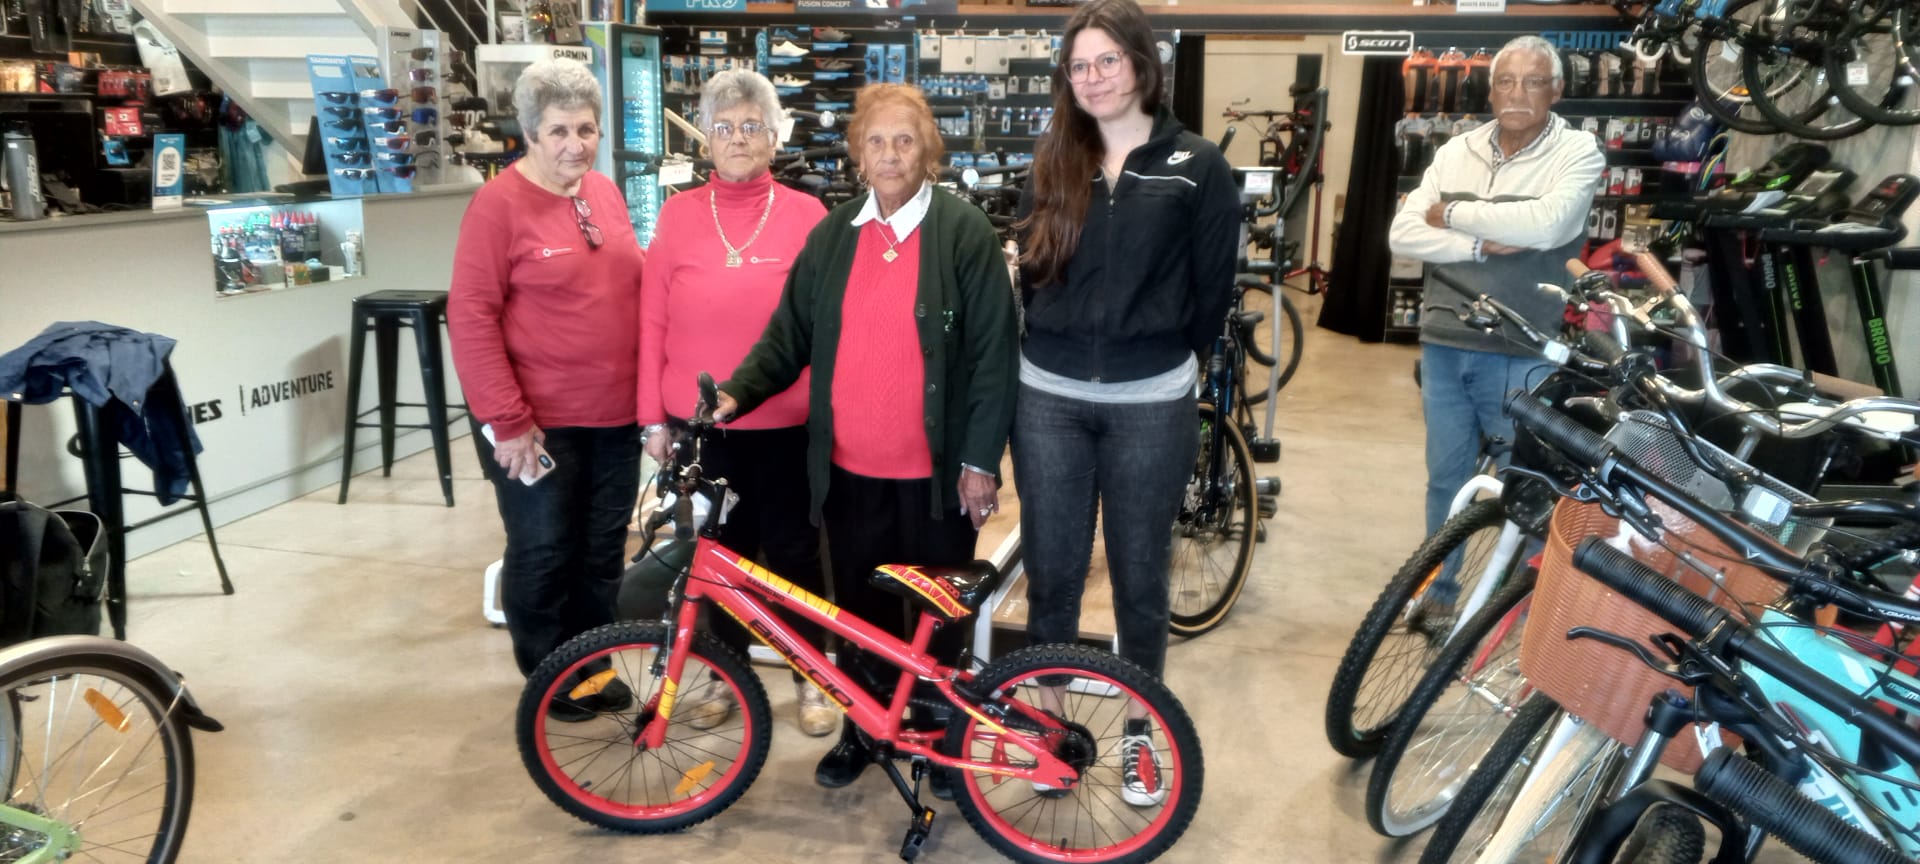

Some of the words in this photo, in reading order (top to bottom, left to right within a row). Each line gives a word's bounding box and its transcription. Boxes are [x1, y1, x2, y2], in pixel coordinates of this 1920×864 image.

[821, 0, 851, 8] CONCEPT
[1359, 39, 1409, 47] SCOTT
[553, 49, 588, 61] GARMIN
[1868, 317, 1891, 365] BRAVO
[251, 371, 334, 409] ADVENTURE
